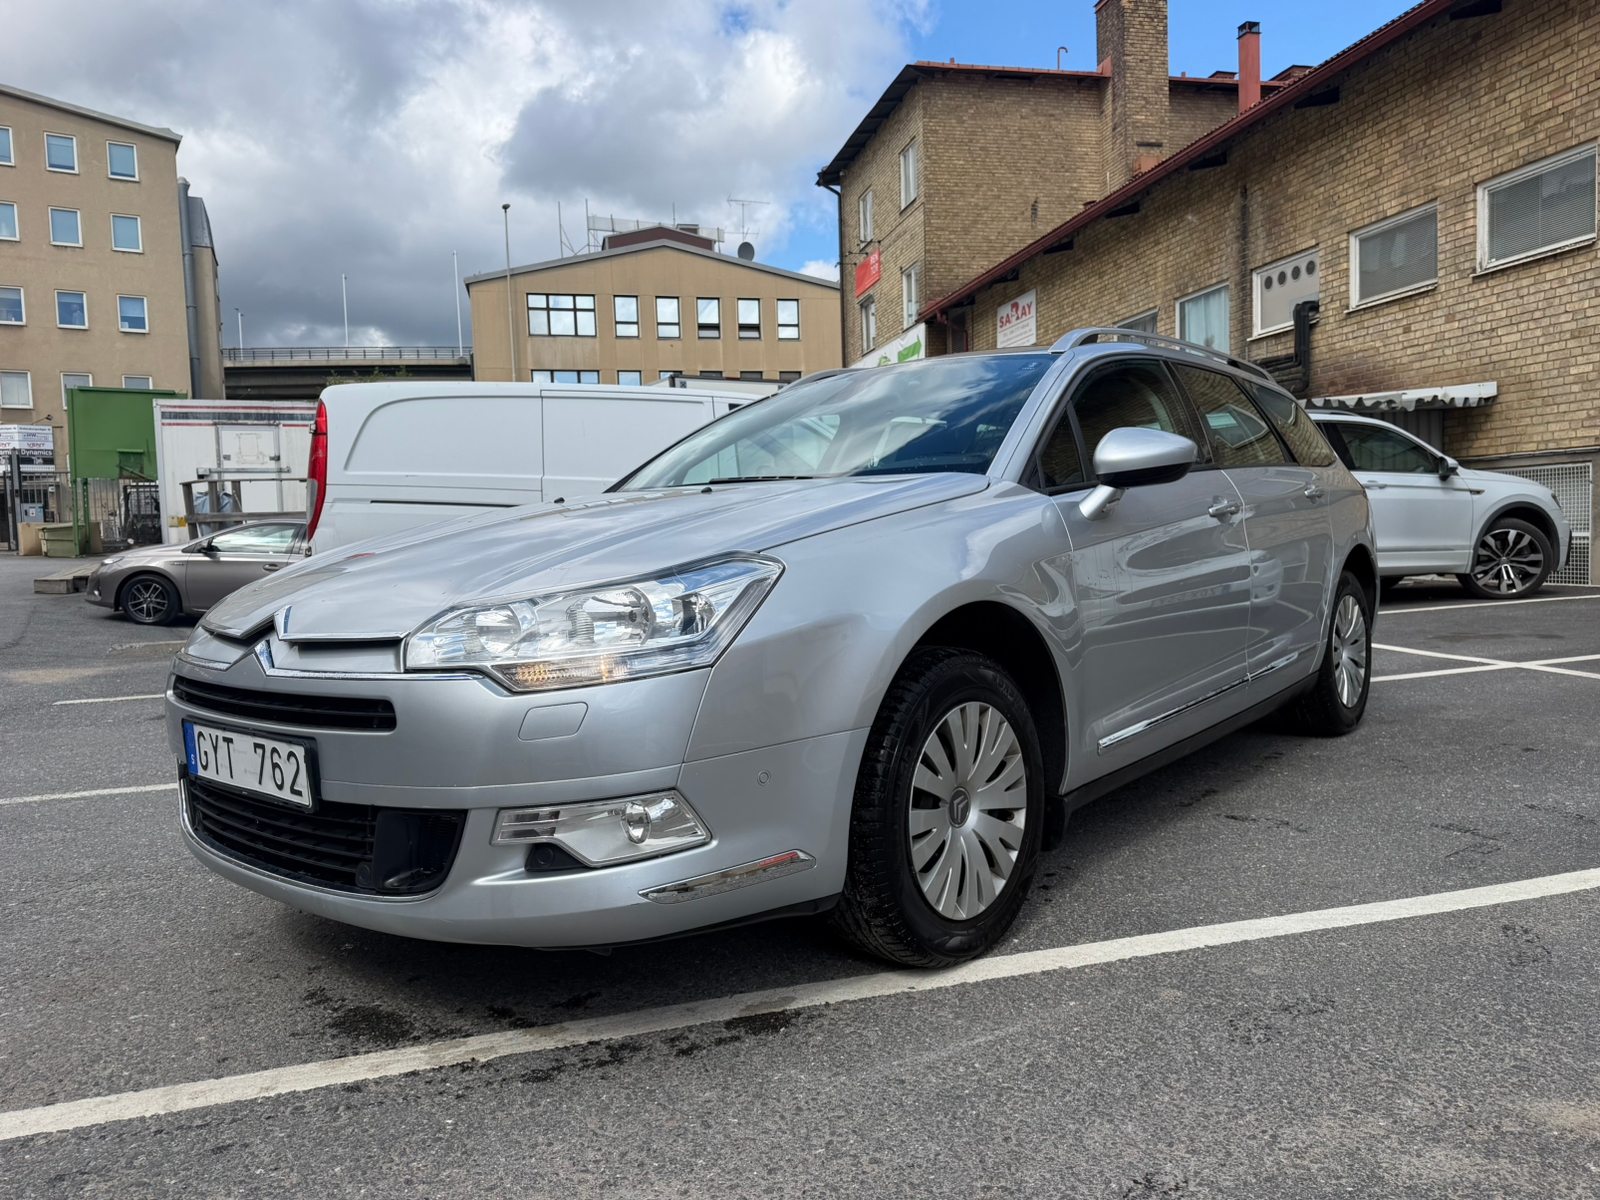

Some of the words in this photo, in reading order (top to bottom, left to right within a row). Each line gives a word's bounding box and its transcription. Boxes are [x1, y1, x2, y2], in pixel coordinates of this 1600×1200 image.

[999, 301, 1033, 329] SARAY
[20, 448, 53, 456] Dynamics
[191, 753, 196, 765] S
[197, 730, 234, 780] GYT
[252, 741, 303, 798] 762
